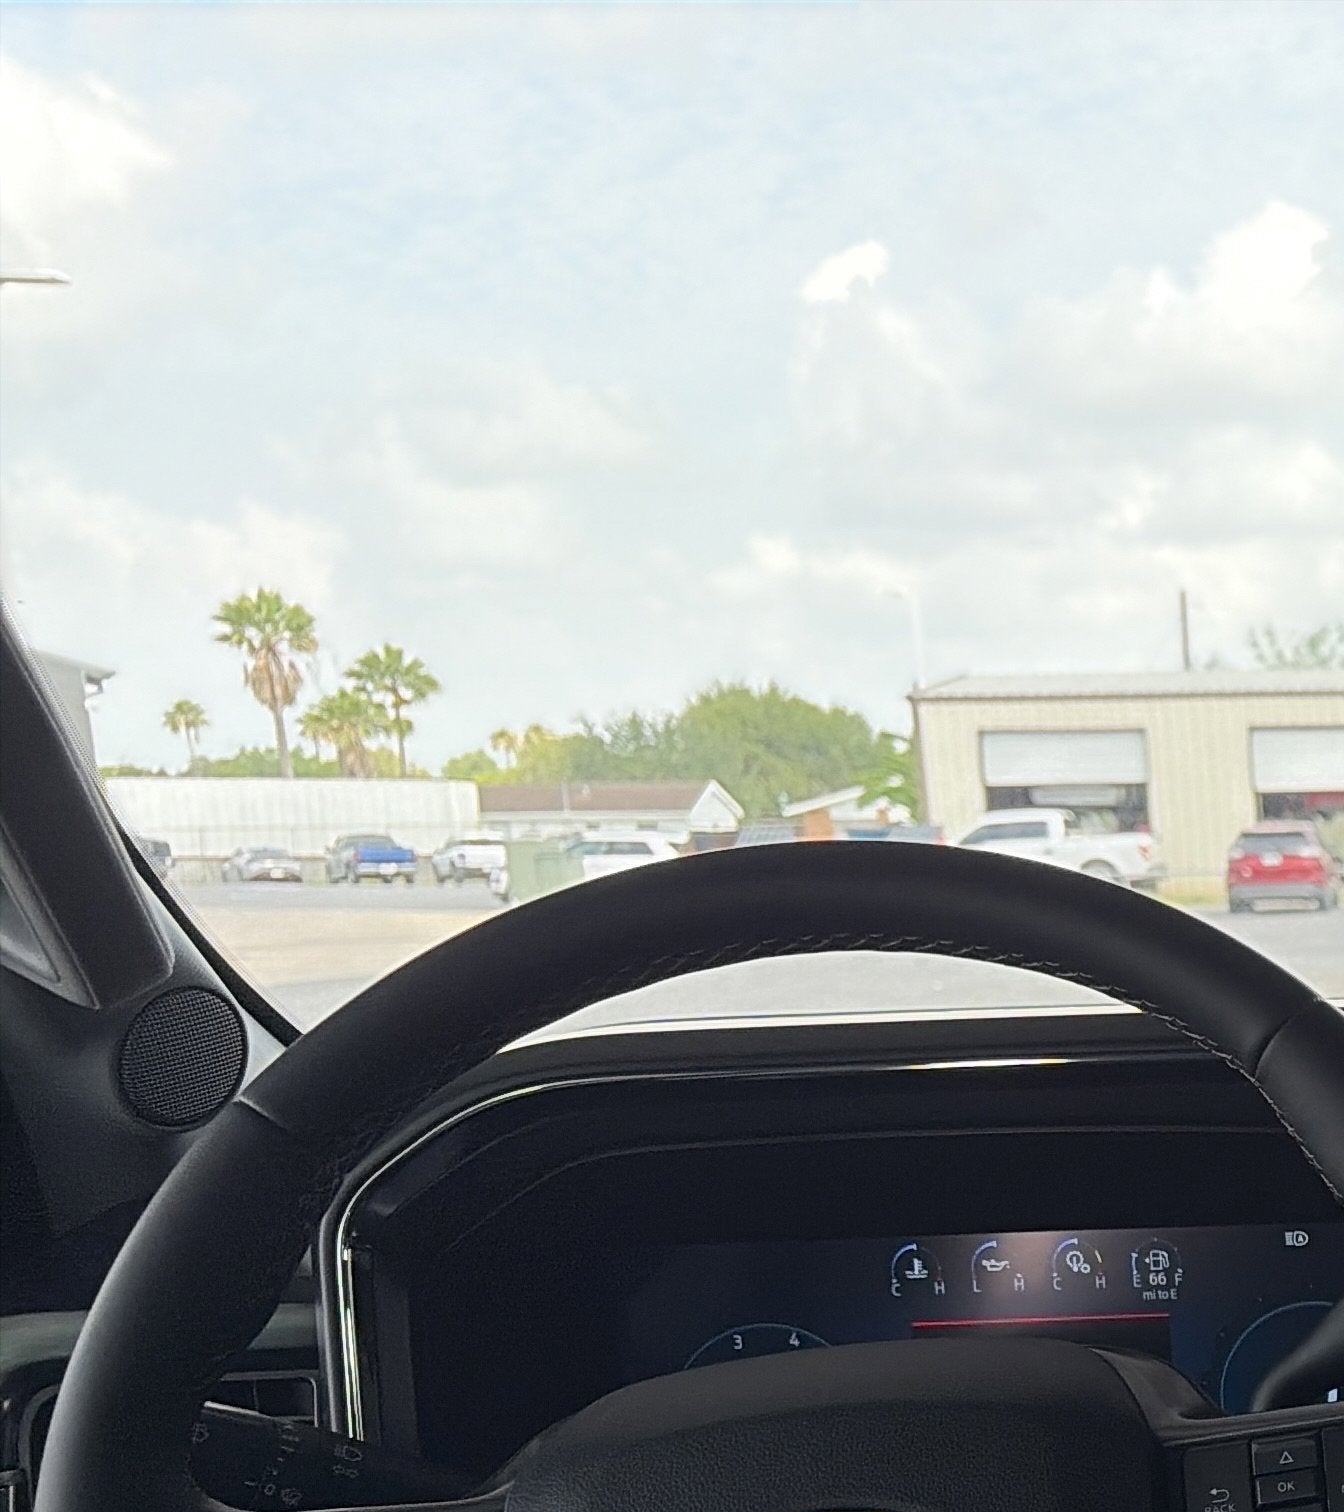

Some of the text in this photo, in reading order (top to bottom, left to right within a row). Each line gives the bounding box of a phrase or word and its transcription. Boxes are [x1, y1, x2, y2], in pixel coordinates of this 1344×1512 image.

[1014, 1278, 1025, 1292] H
[1095, 1276, 1106, 1289] H
[1133, 1275, 1142, 1288] E
[1149, 1273, 1167, 1287] 66
[934, 1281, 945, 1296] H
[1143, 1289, 1157, 1301] mi
[1157, 1289, 1169, 1300] to
[732, 1334, 743, 1350] 3
[789, 1332, 800, 1348] 4
[1277, 1482, 1296, 1493] OK
